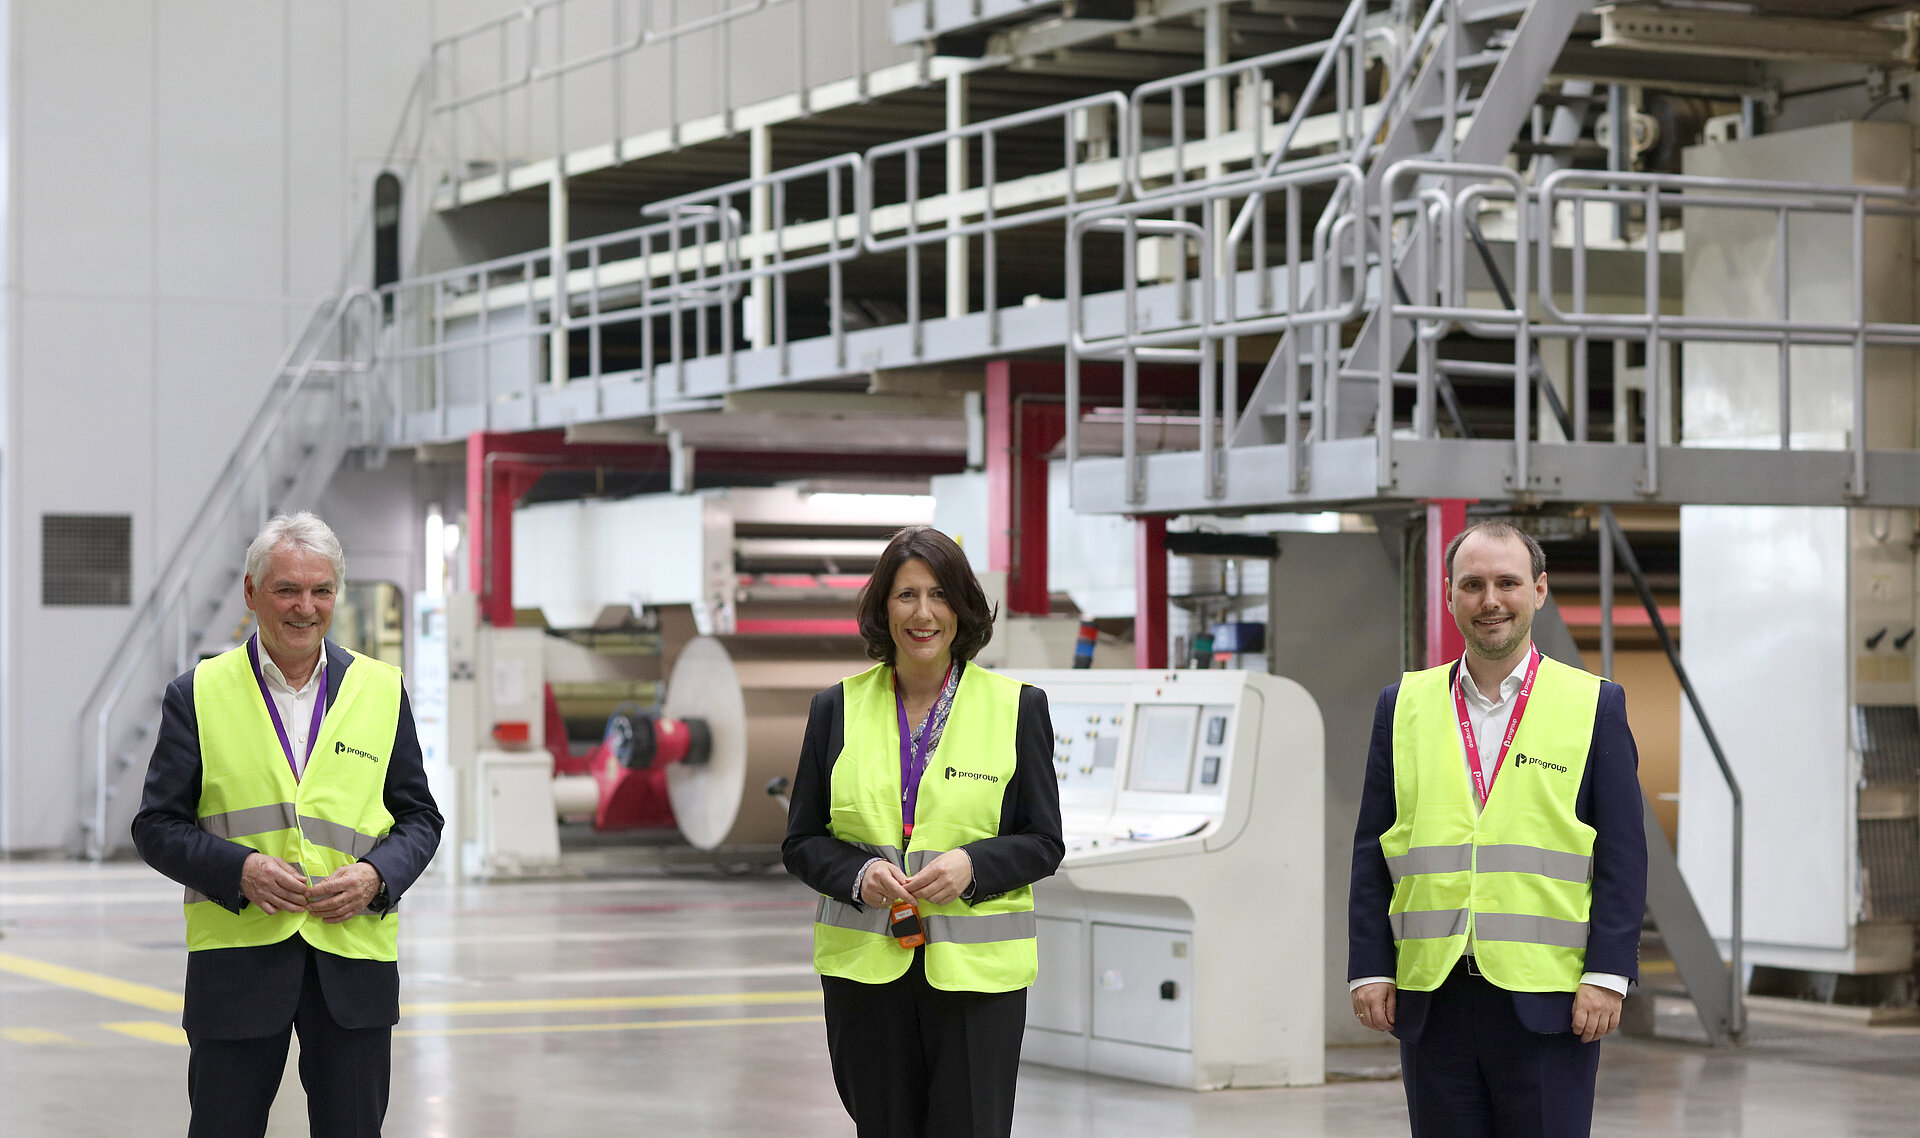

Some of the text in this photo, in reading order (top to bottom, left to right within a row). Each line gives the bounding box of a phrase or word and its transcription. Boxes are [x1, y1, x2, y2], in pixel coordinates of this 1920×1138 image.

[1465, 727, 1474, 748] progroup
[1507, 718, 1517, 741] progroup
[347, 746, 379, 763] progroup
[1528, 757, 1568, 773] progroup
[958, 771, 999, 783] progroup
